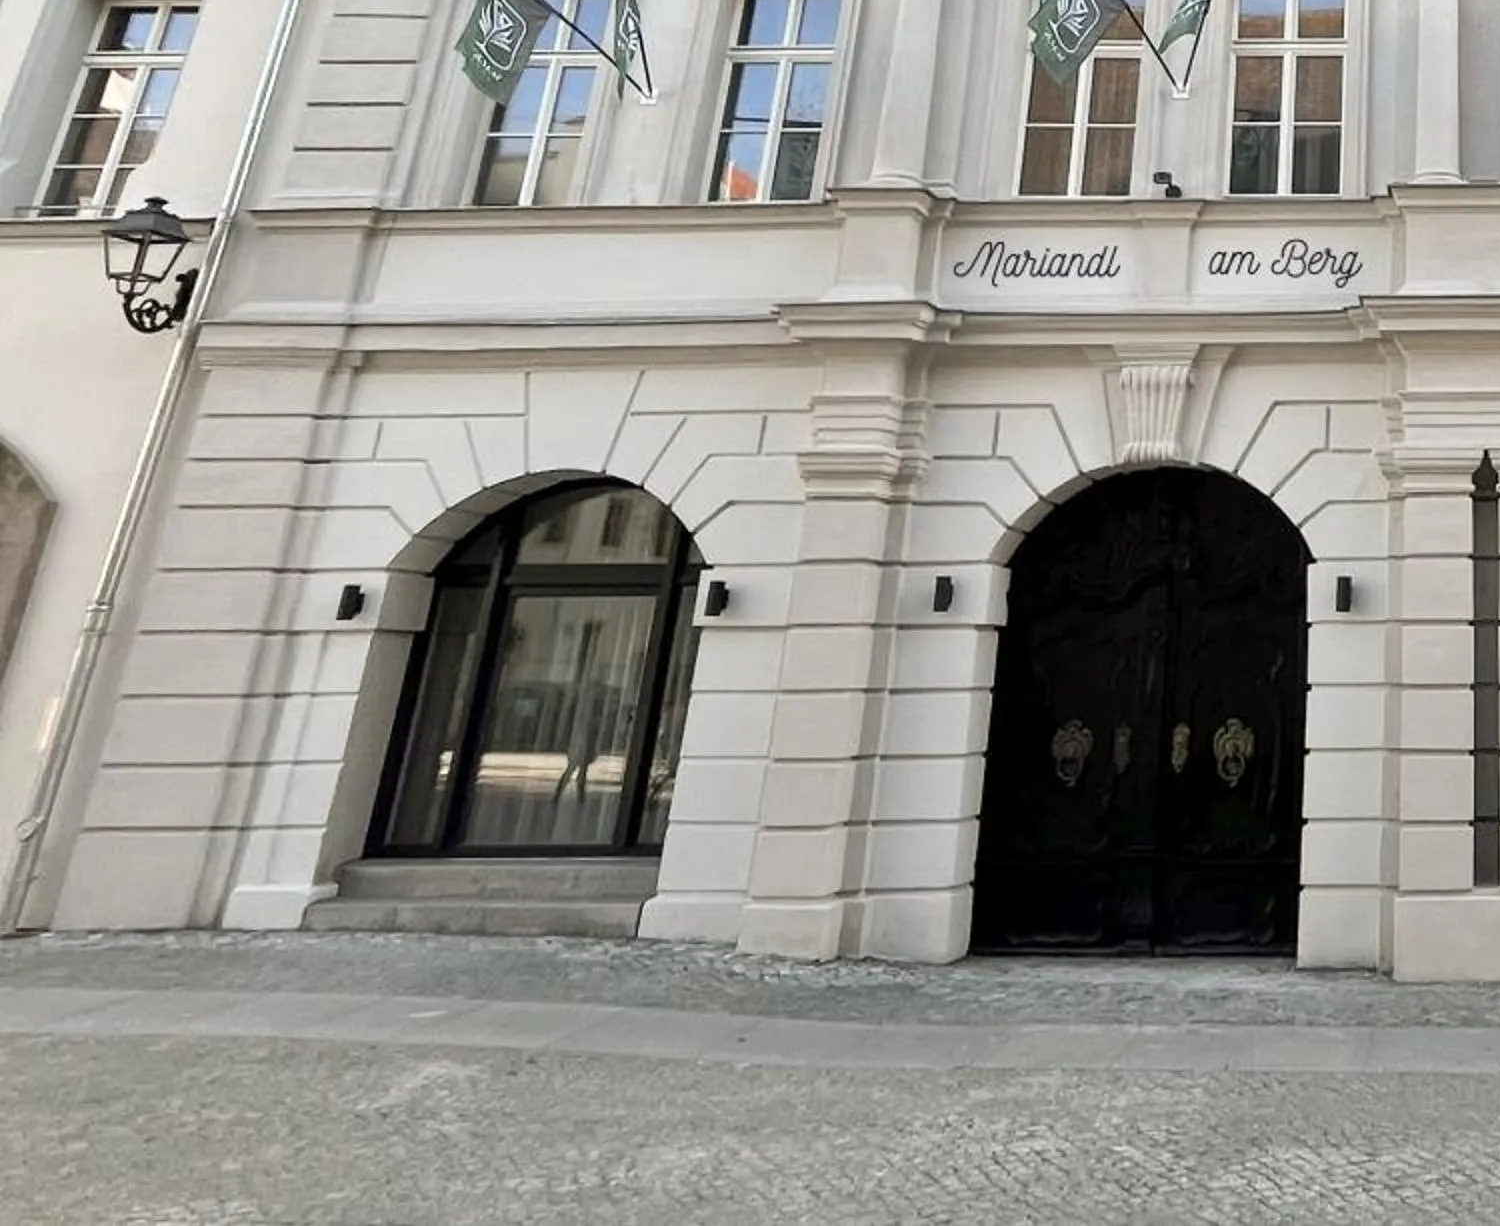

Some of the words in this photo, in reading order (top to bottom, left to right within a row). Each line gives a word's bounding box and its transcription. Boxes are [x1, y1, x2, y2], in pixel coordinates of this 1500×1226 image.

[953, 241, 1121, 287] Mariandl
[1208, 251, 1261, 275] am
[1270, 239, 1363, 289] Berg
